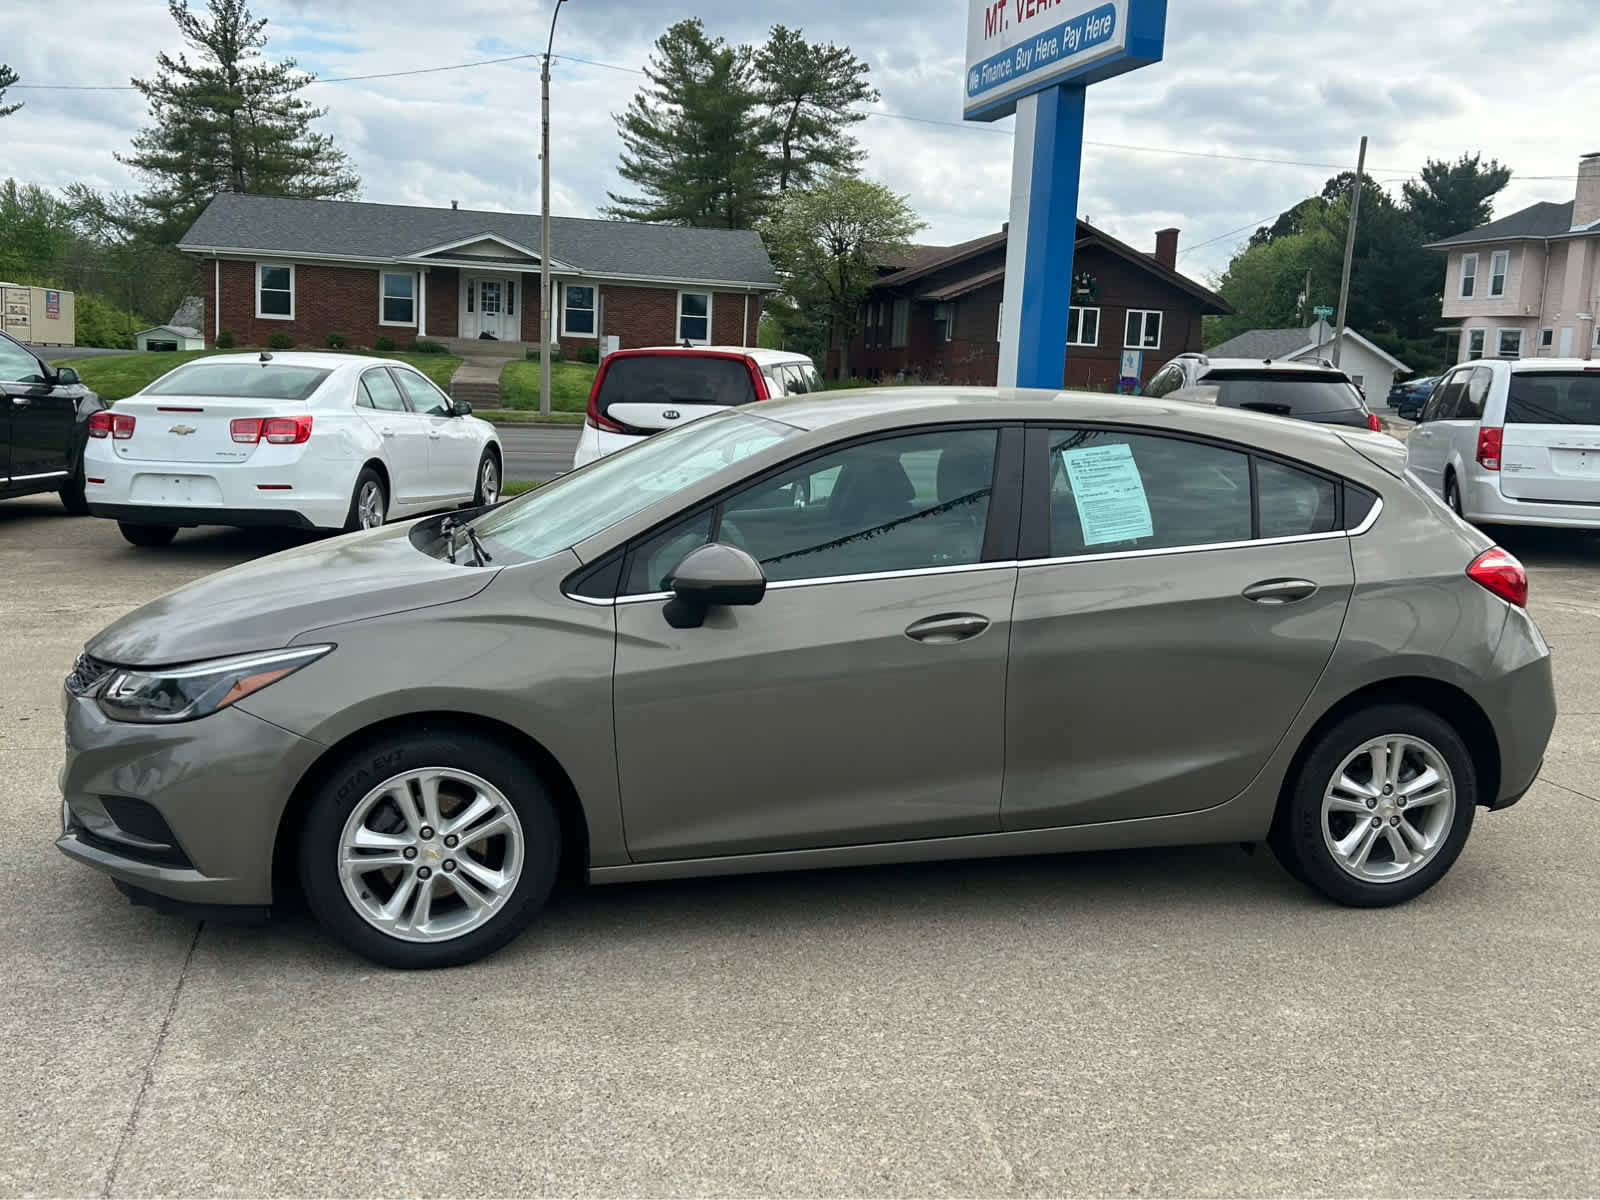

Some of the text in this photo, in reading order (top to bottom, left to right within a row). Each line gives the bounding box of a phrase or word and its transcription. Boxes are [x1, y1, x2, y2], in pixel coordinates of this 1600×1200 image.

[981, 58, 1012, 86] Finance,
[1016, 48, 1032, 71] Buy
[1035, 38, 1058, 62] Here,
[1063, 26, 1081, 51] Pay
[1085, 15, 1111, 41] Here
